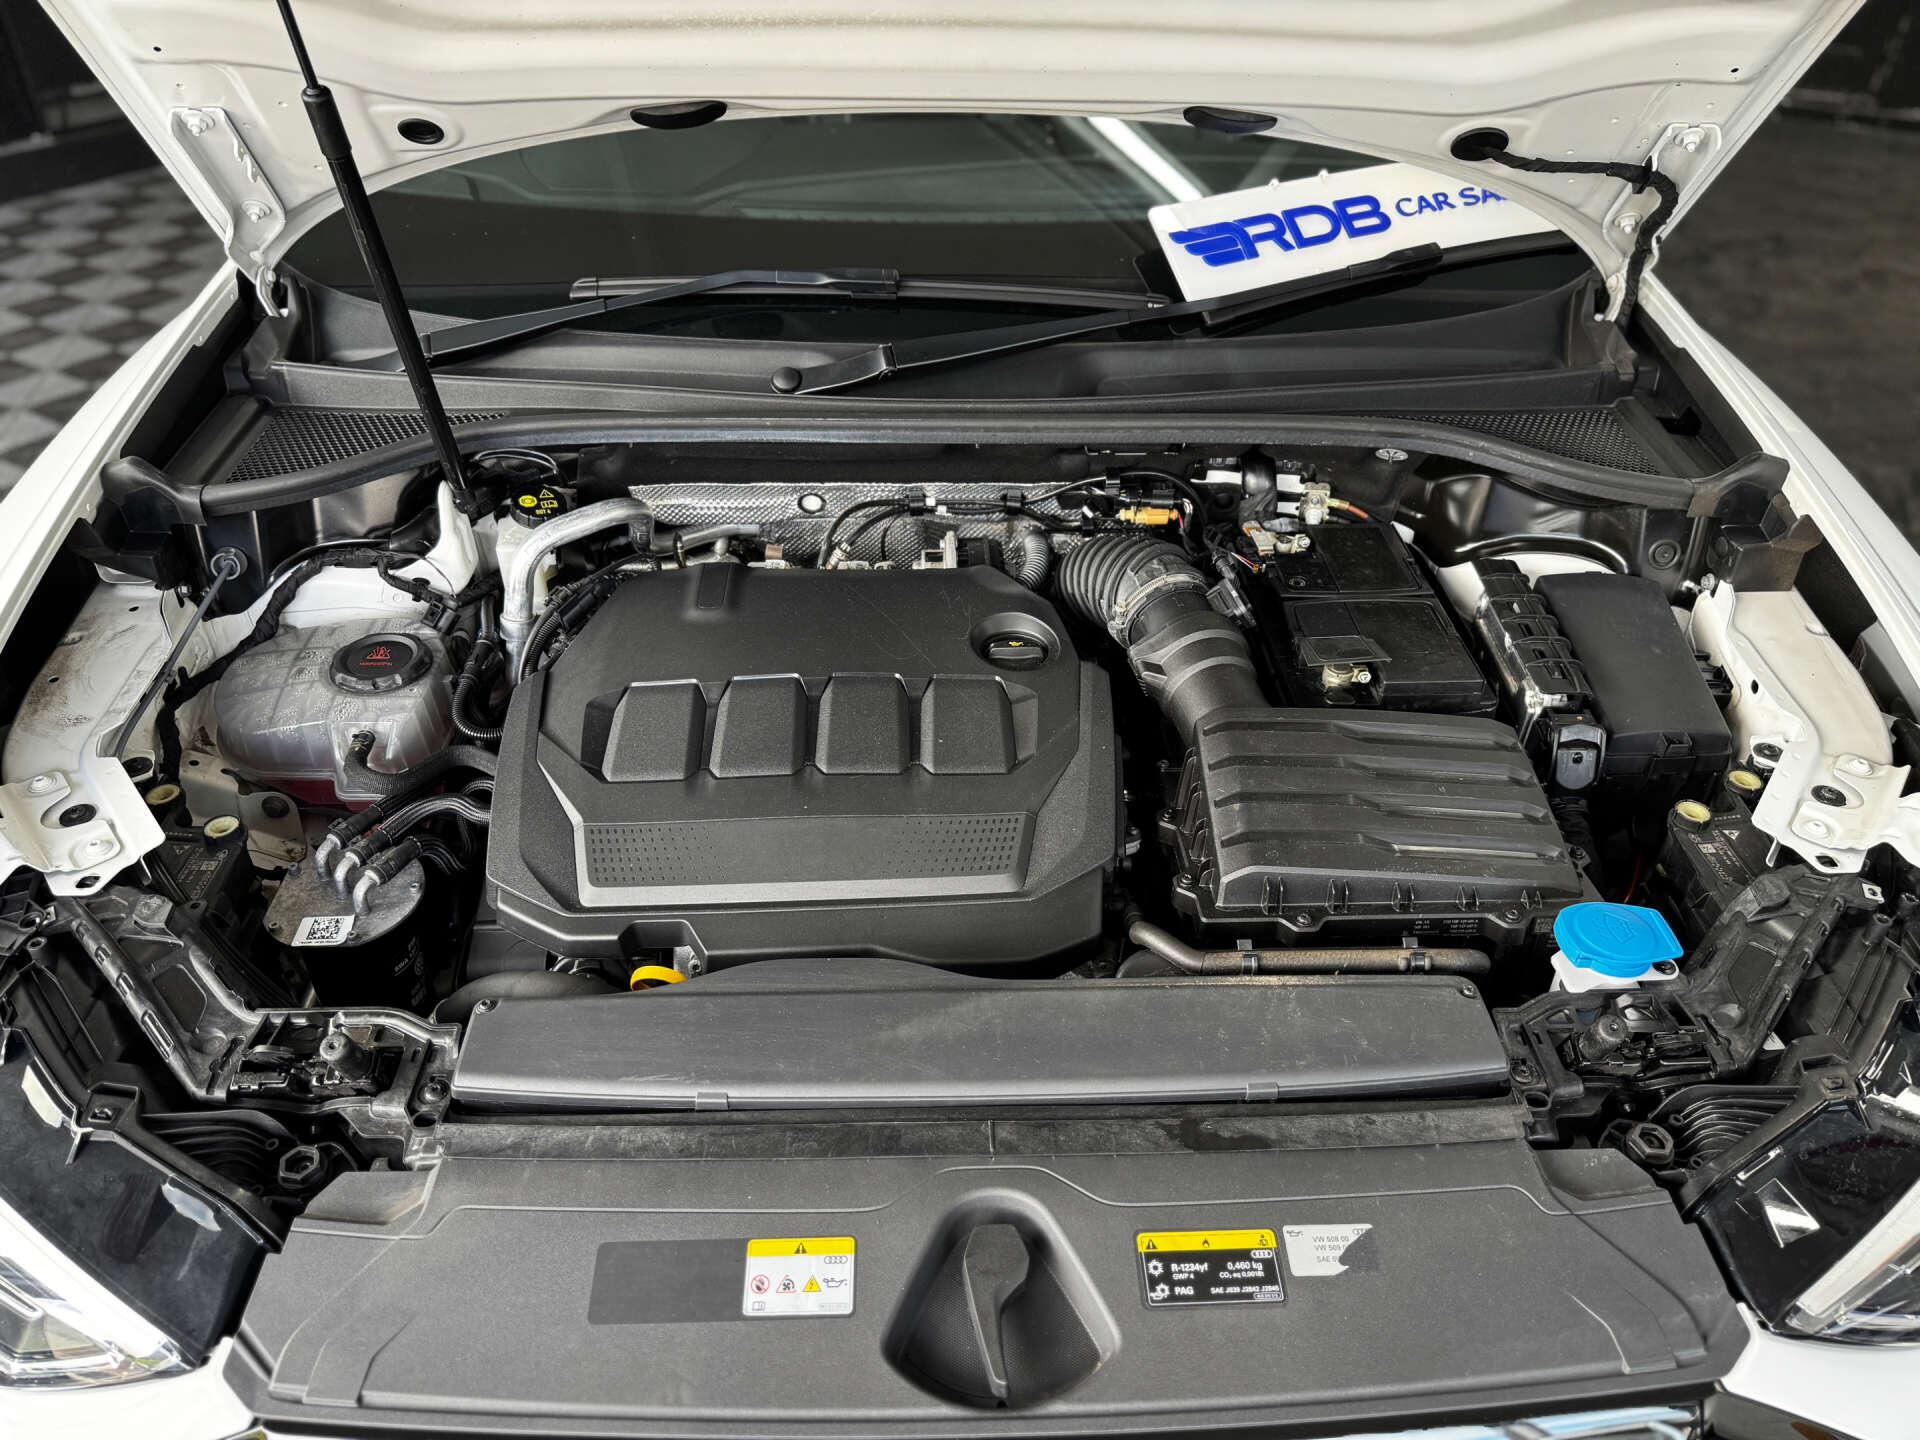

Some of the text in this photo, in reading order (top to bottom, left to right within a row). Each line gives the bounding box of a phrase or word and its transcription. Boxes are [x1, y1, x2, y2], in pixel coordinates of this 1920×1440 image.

[1232, 187, 1508, 261] RDB CAR SA
[1312, 1235, 1325, 1243] VW
[1317, 1255, 1330, 1263] SAE
[1171, 1262, 1208, 1273] R-1234yf
[1252, 1260, 1263, 1271] kg
[1174, 1286, 1194, 1295] PAG
